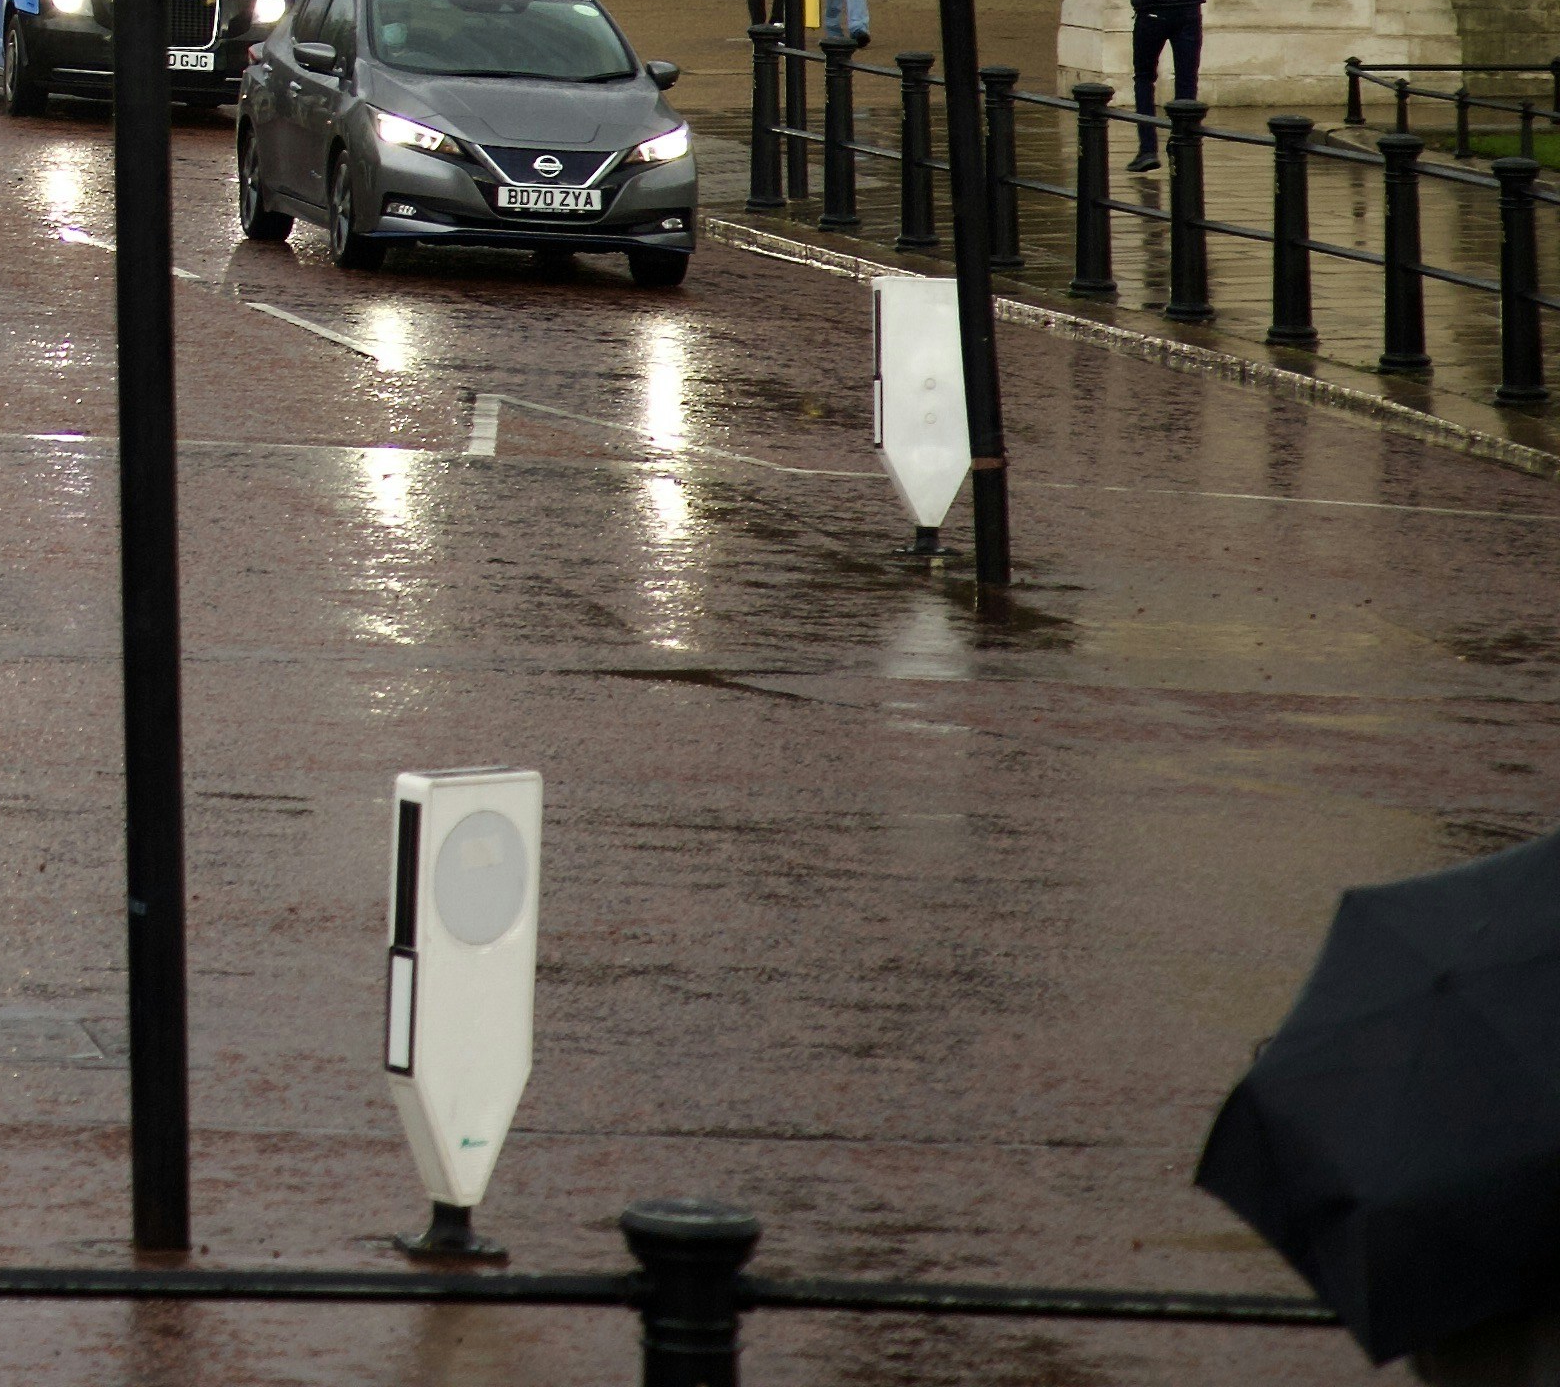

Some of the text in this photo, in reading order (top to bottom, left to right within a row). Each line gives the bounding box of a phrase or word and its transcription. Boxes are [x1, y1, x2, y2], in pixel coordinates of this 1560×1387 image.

[180, 54, 209, 68] GJG
[507, 188, 594, 208] BD70 ZYA
